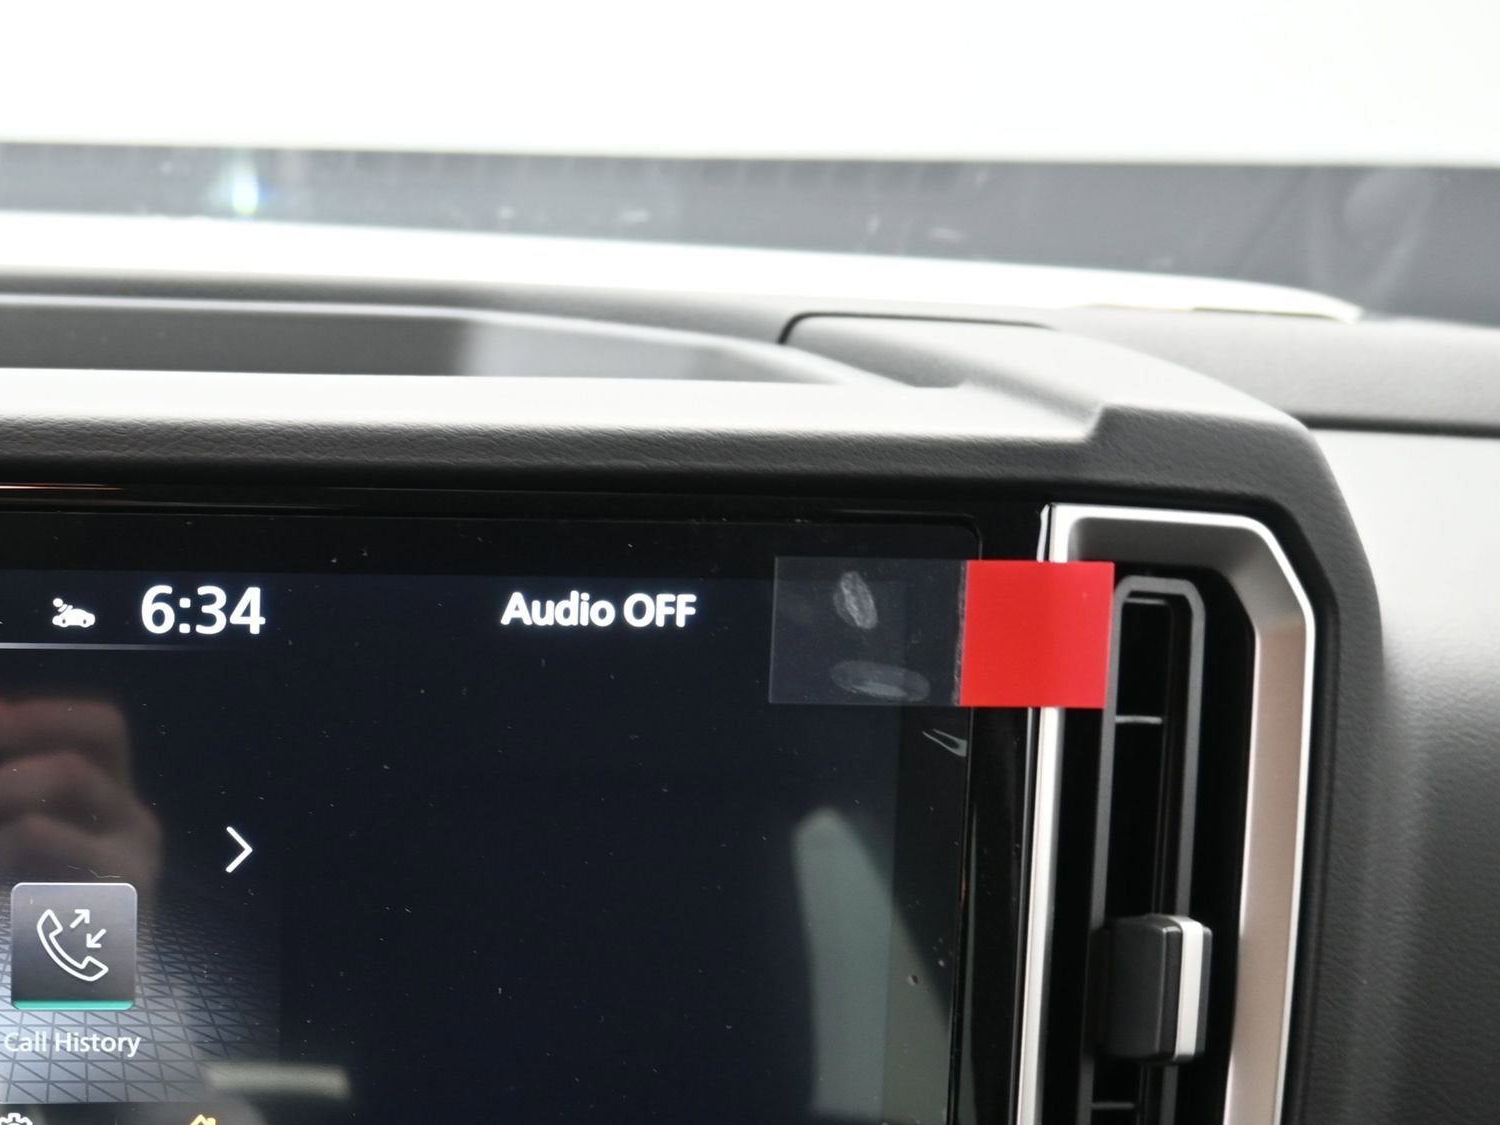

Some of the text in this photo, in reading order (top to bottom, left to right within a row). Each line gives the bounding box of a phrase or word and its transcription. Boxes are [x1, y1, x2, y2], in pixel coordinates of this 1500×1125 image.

[140, 584, 266, 635] 6:34
[500, 591, 698, 628] Audio OFF
[2, 1031, 142, 1058] Call History
